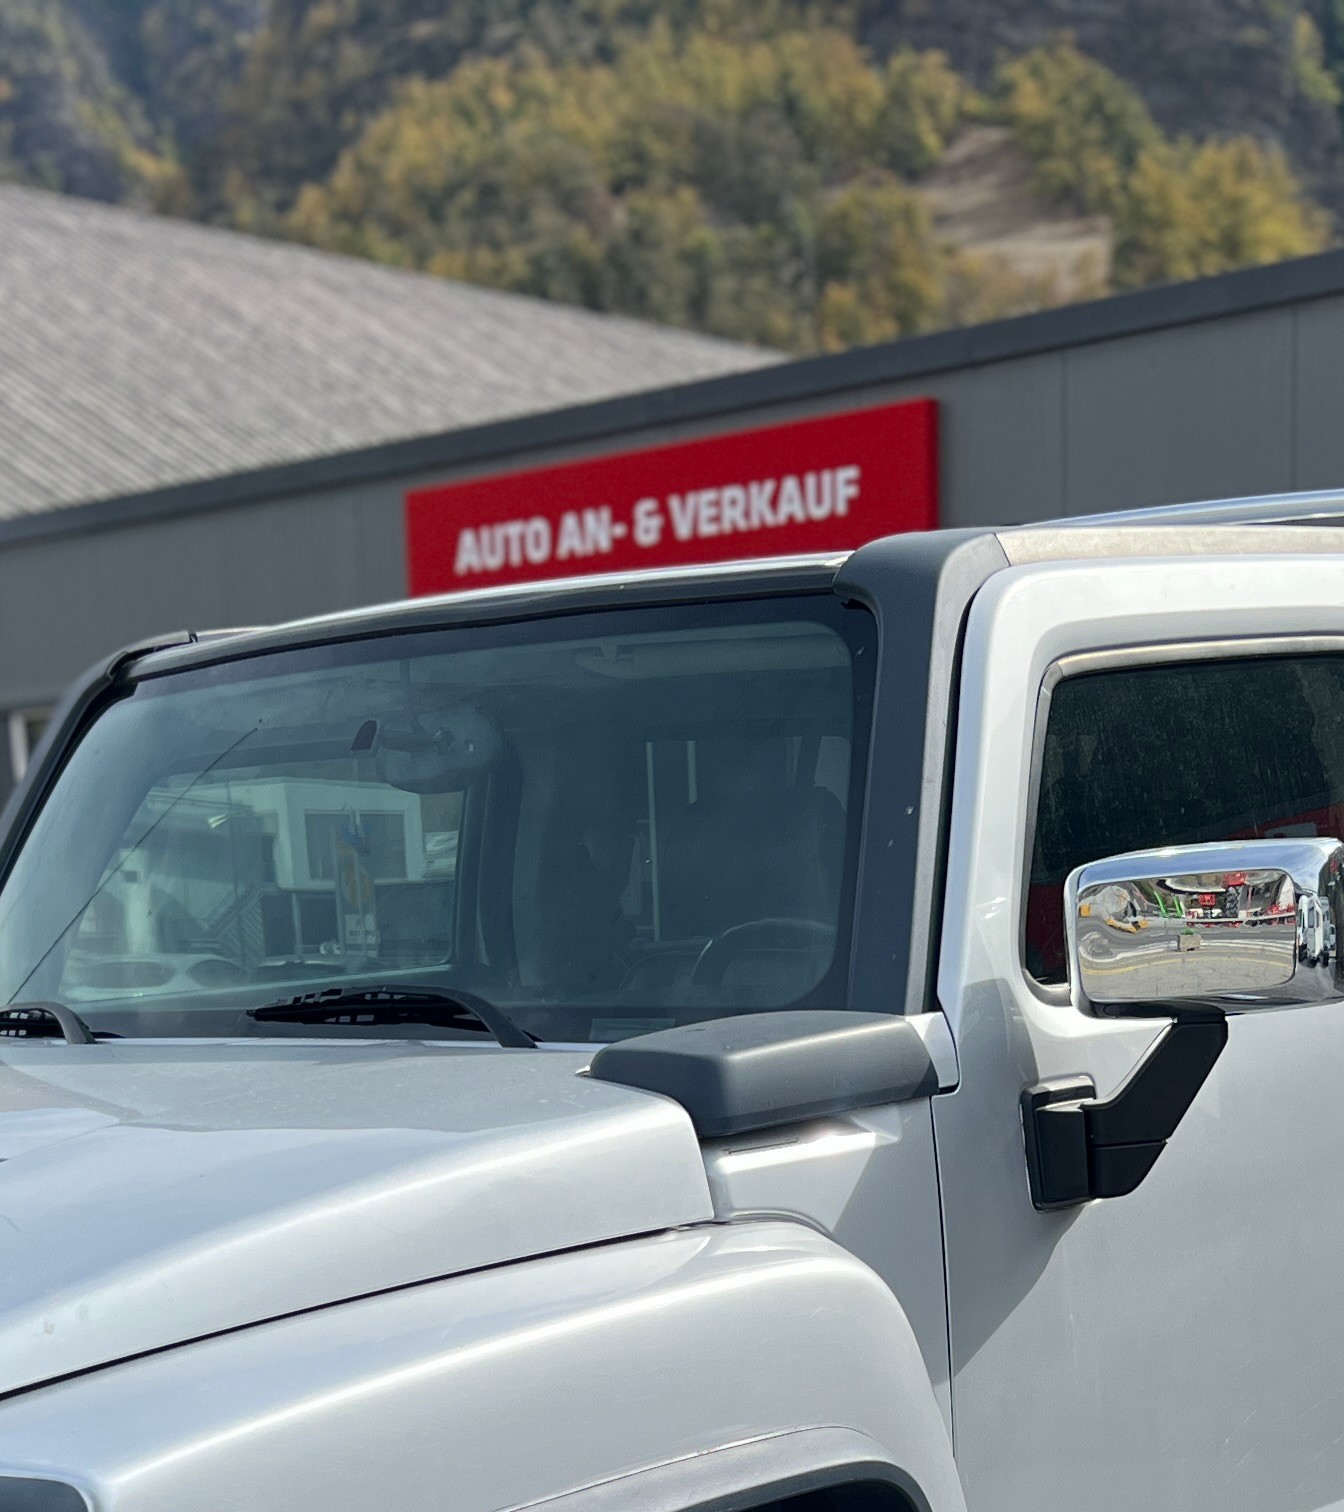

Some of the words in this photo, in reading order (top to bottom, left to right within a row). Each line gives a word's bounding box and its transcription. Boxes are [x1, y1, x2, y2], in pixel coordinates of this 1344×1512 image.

[455, 516, 552, 575] AUTO
[556, 506, 626, 560] AN-
[633, 499, 664, 548] &
[669, 465, 860, 541] VERKAUF
